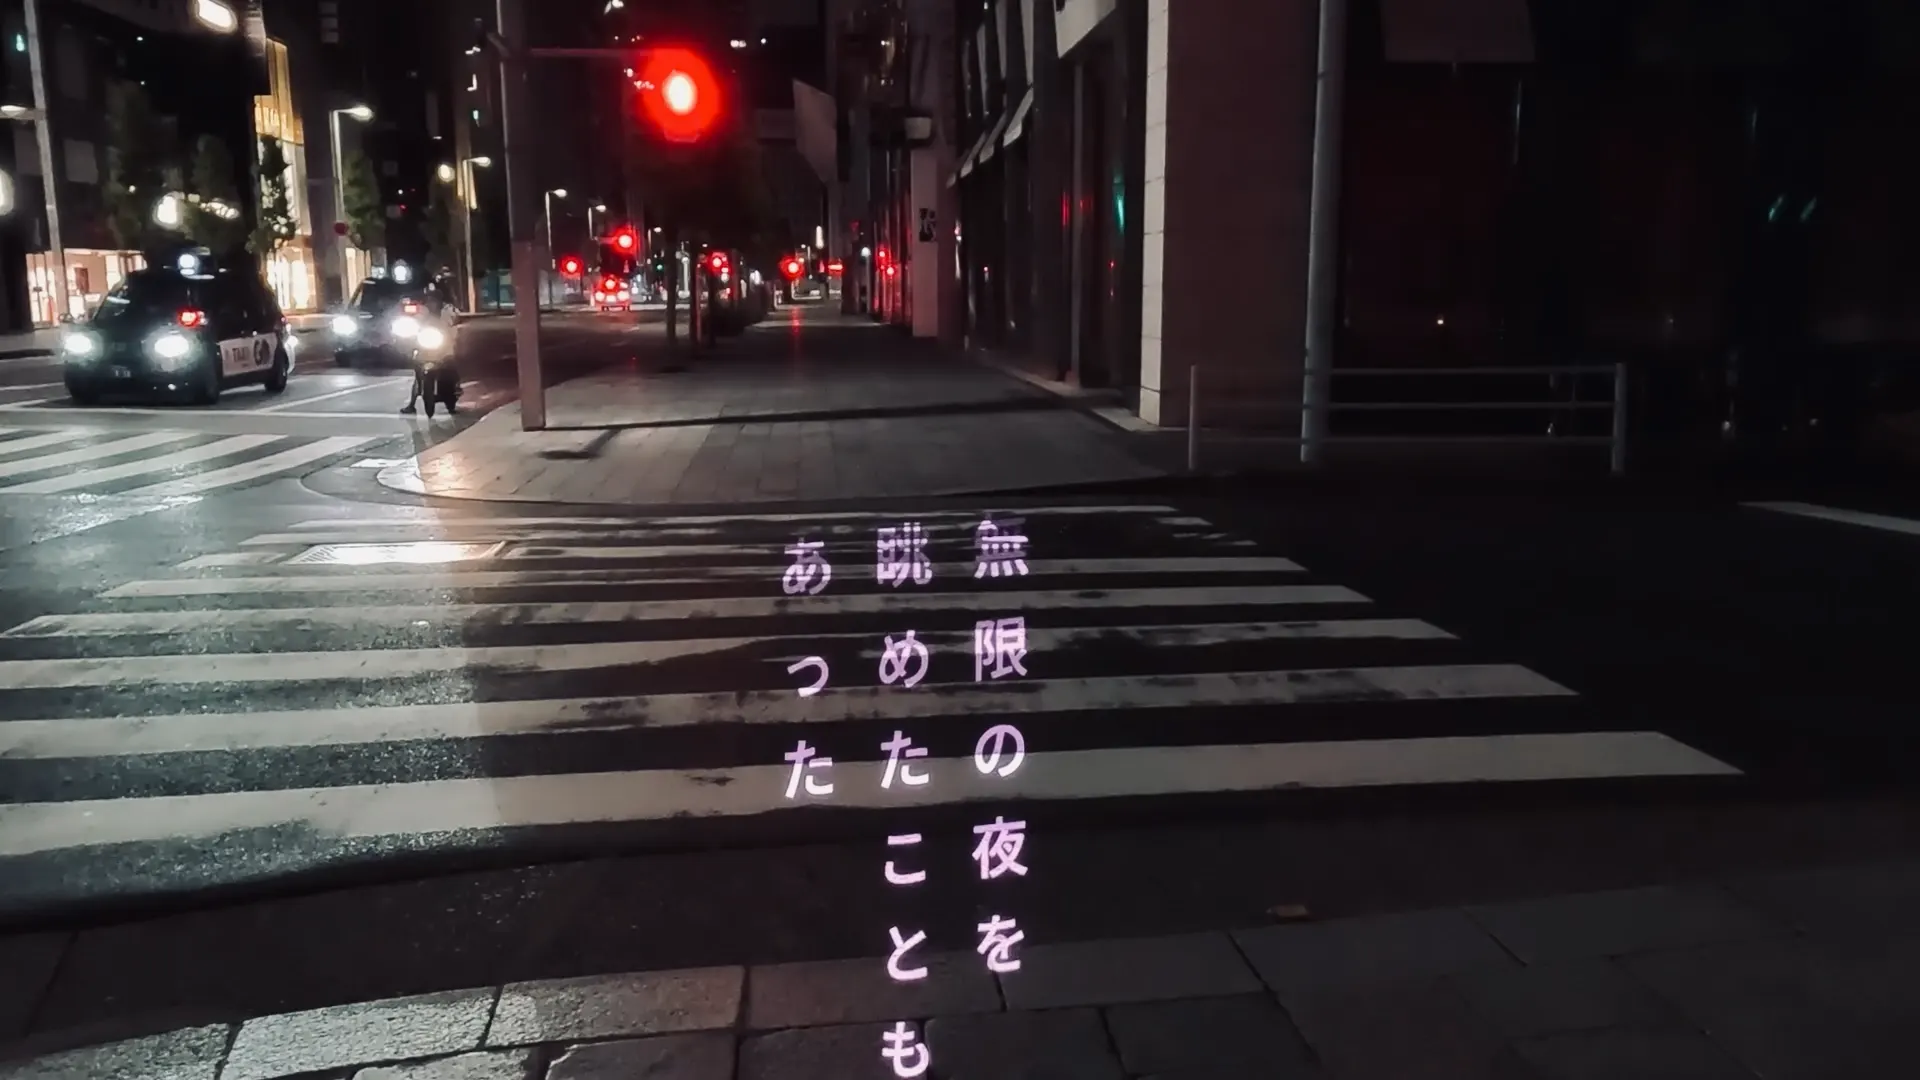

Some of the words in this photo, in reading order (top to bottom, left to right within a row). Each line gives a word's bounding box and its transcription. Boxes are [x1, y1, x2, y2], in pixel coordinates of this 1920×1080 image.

[782, 537, 834, 798] あった
[876, 522, 933, 1078] 眺めたことも
[971, 513, 1029, 973] 無限の夜を
